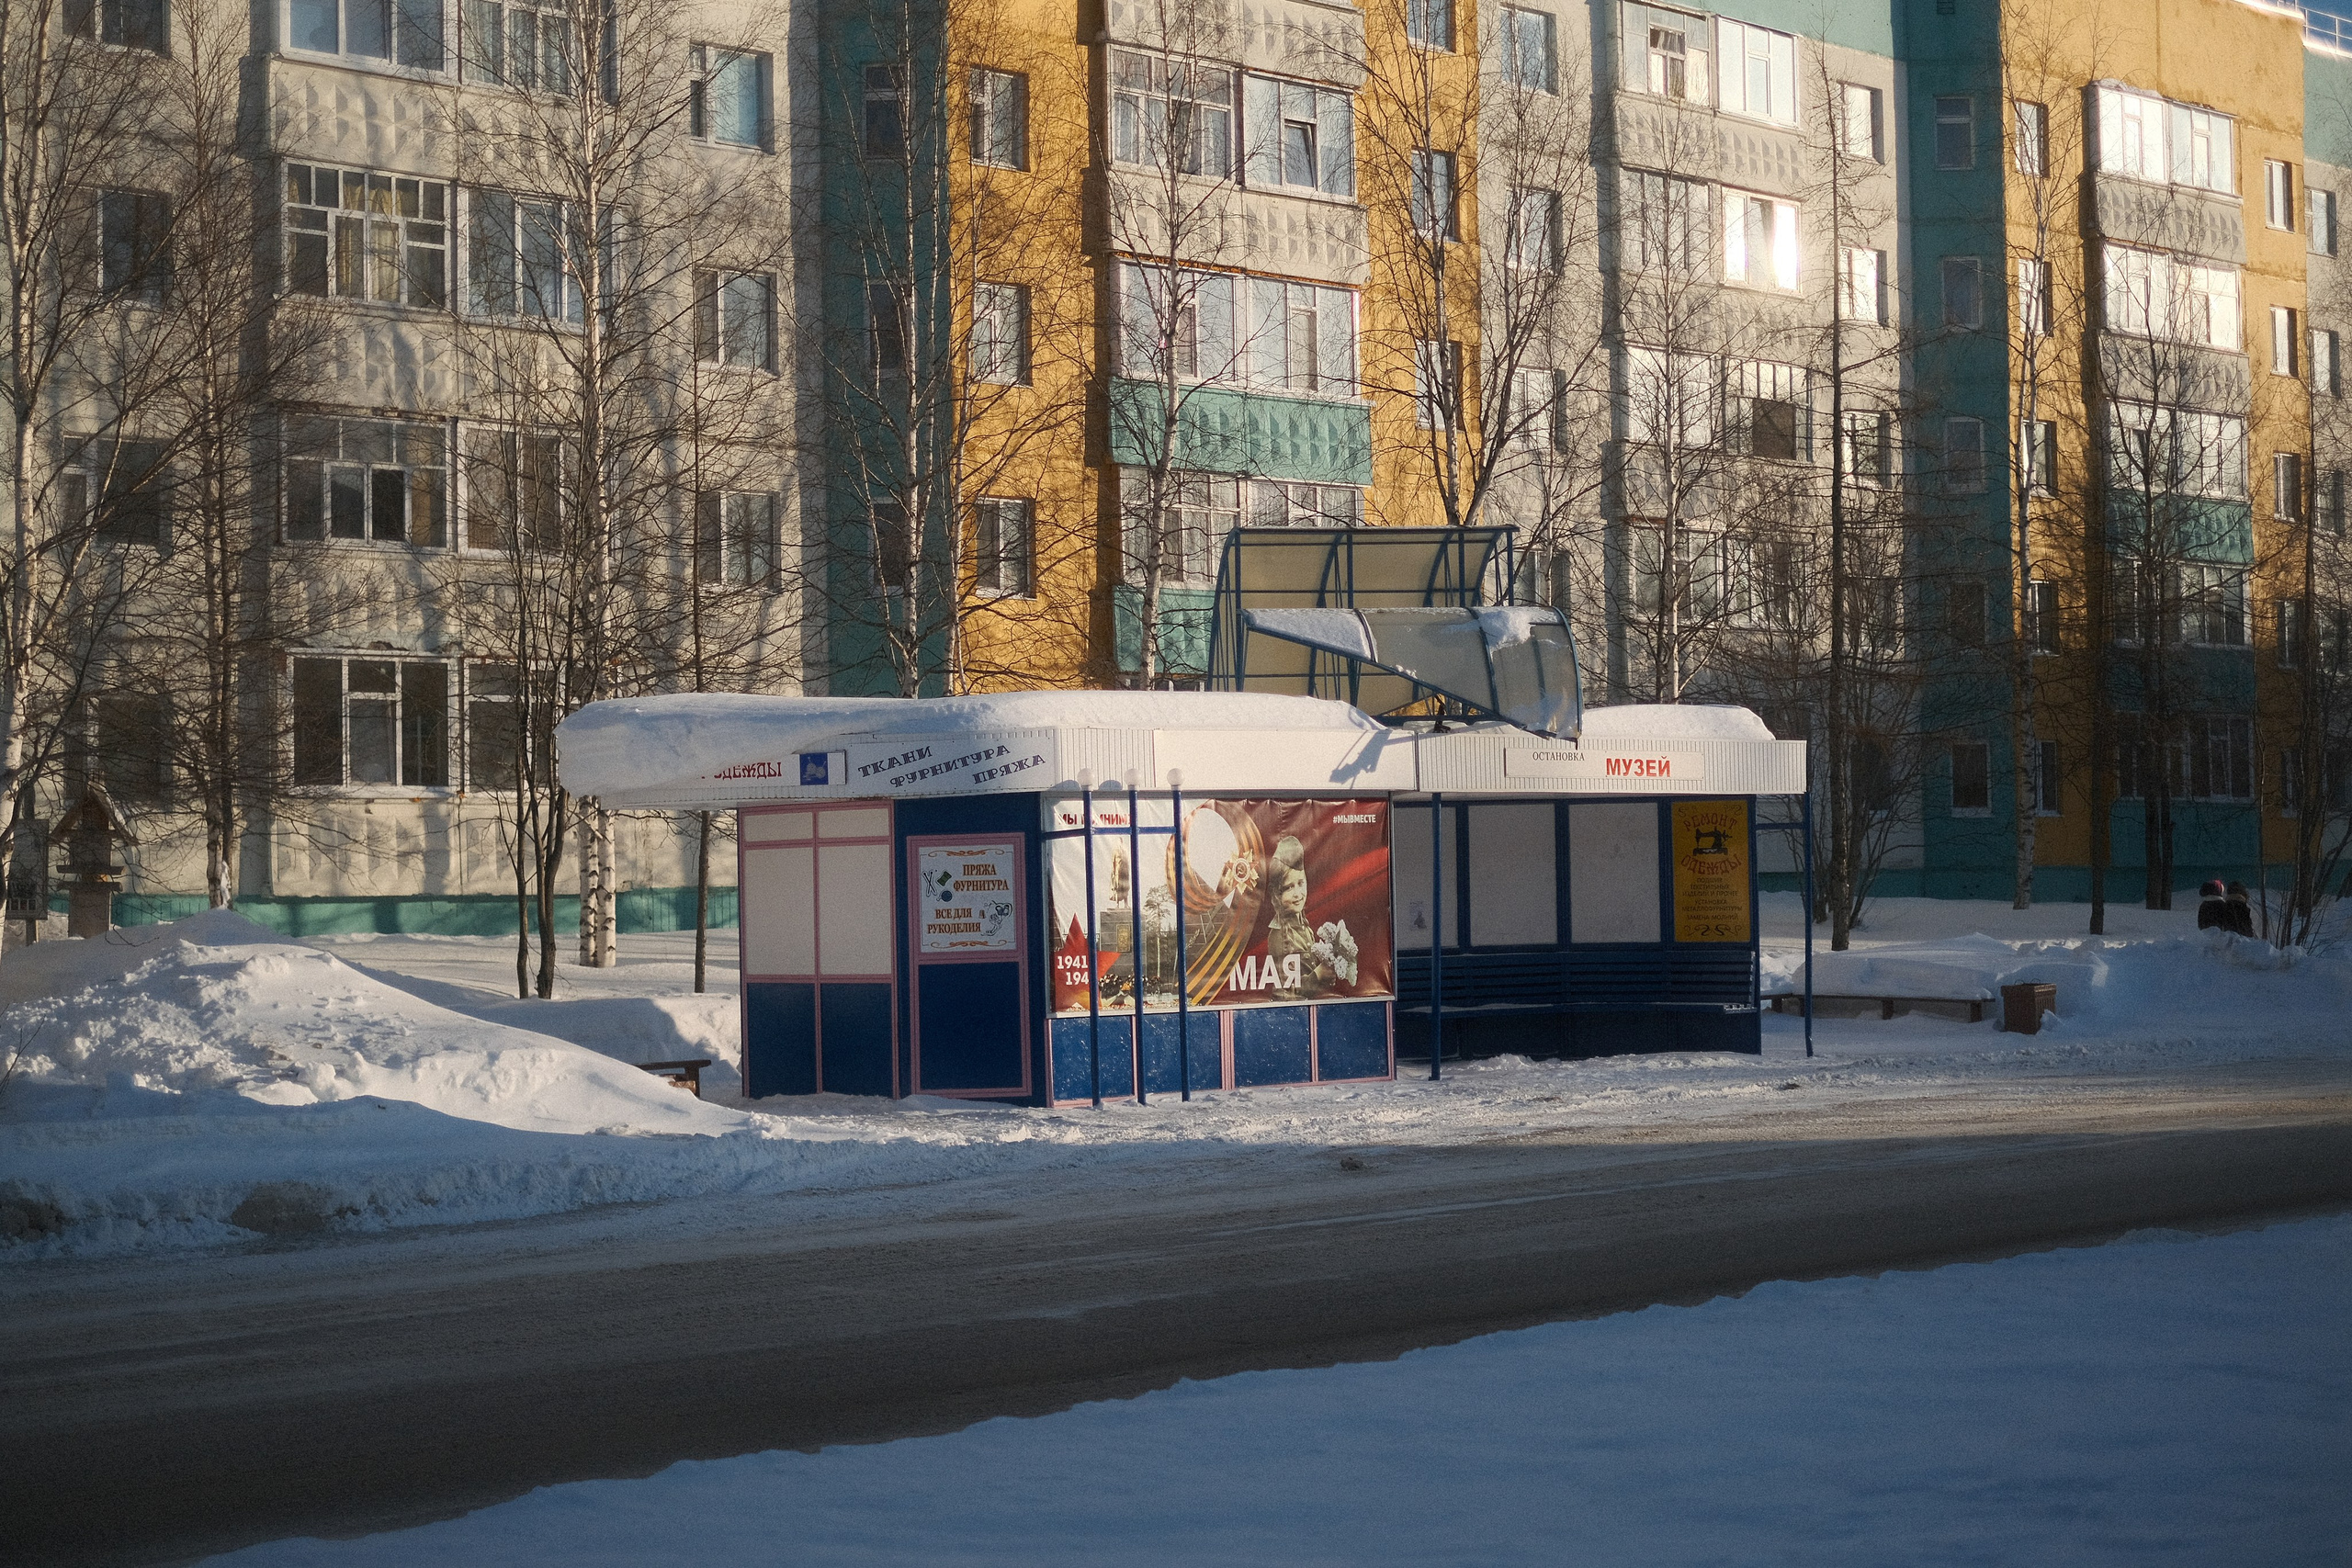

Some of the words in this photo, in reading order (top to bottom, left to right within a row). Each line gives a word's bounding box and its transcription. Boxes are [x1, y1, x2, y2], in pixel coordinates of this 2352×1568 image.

[858, 746, 933, 777] ТКАНИ
[890, 745, 1011, 787] ФУРНИТУРА
[972, 754, 1046, 784] ПРЯЖА
[1532, 751, 1585, 761] ОСТАНОВКА
[1606, 755, 1670, 777] МУЗЕЙ
[714, 762, 782, 780] ДЕЖДЫ
[1333, 814, 1376, 824] #МЫВМЕСТЕ
[1683, 813, 1737, 831] РЕМОНТ
[963, 864, 997, 875] ПРЯЖА
[1681, 854, 1742, 875] ОДЕЖДЫ
[953, 879, 1009, 892] ФУРНИТУРА
[935, 908, 952, 919] ВСЕ
[954, 908, 972, 920] ДЛЯ
[927, 922, 981, 935] РУКОДЕЛИЯ
[1057, 955, 1088, 969] 1941
[1066, 971, 1090, 985] 194
[1229, 953, 1302, 991] МАЯ
